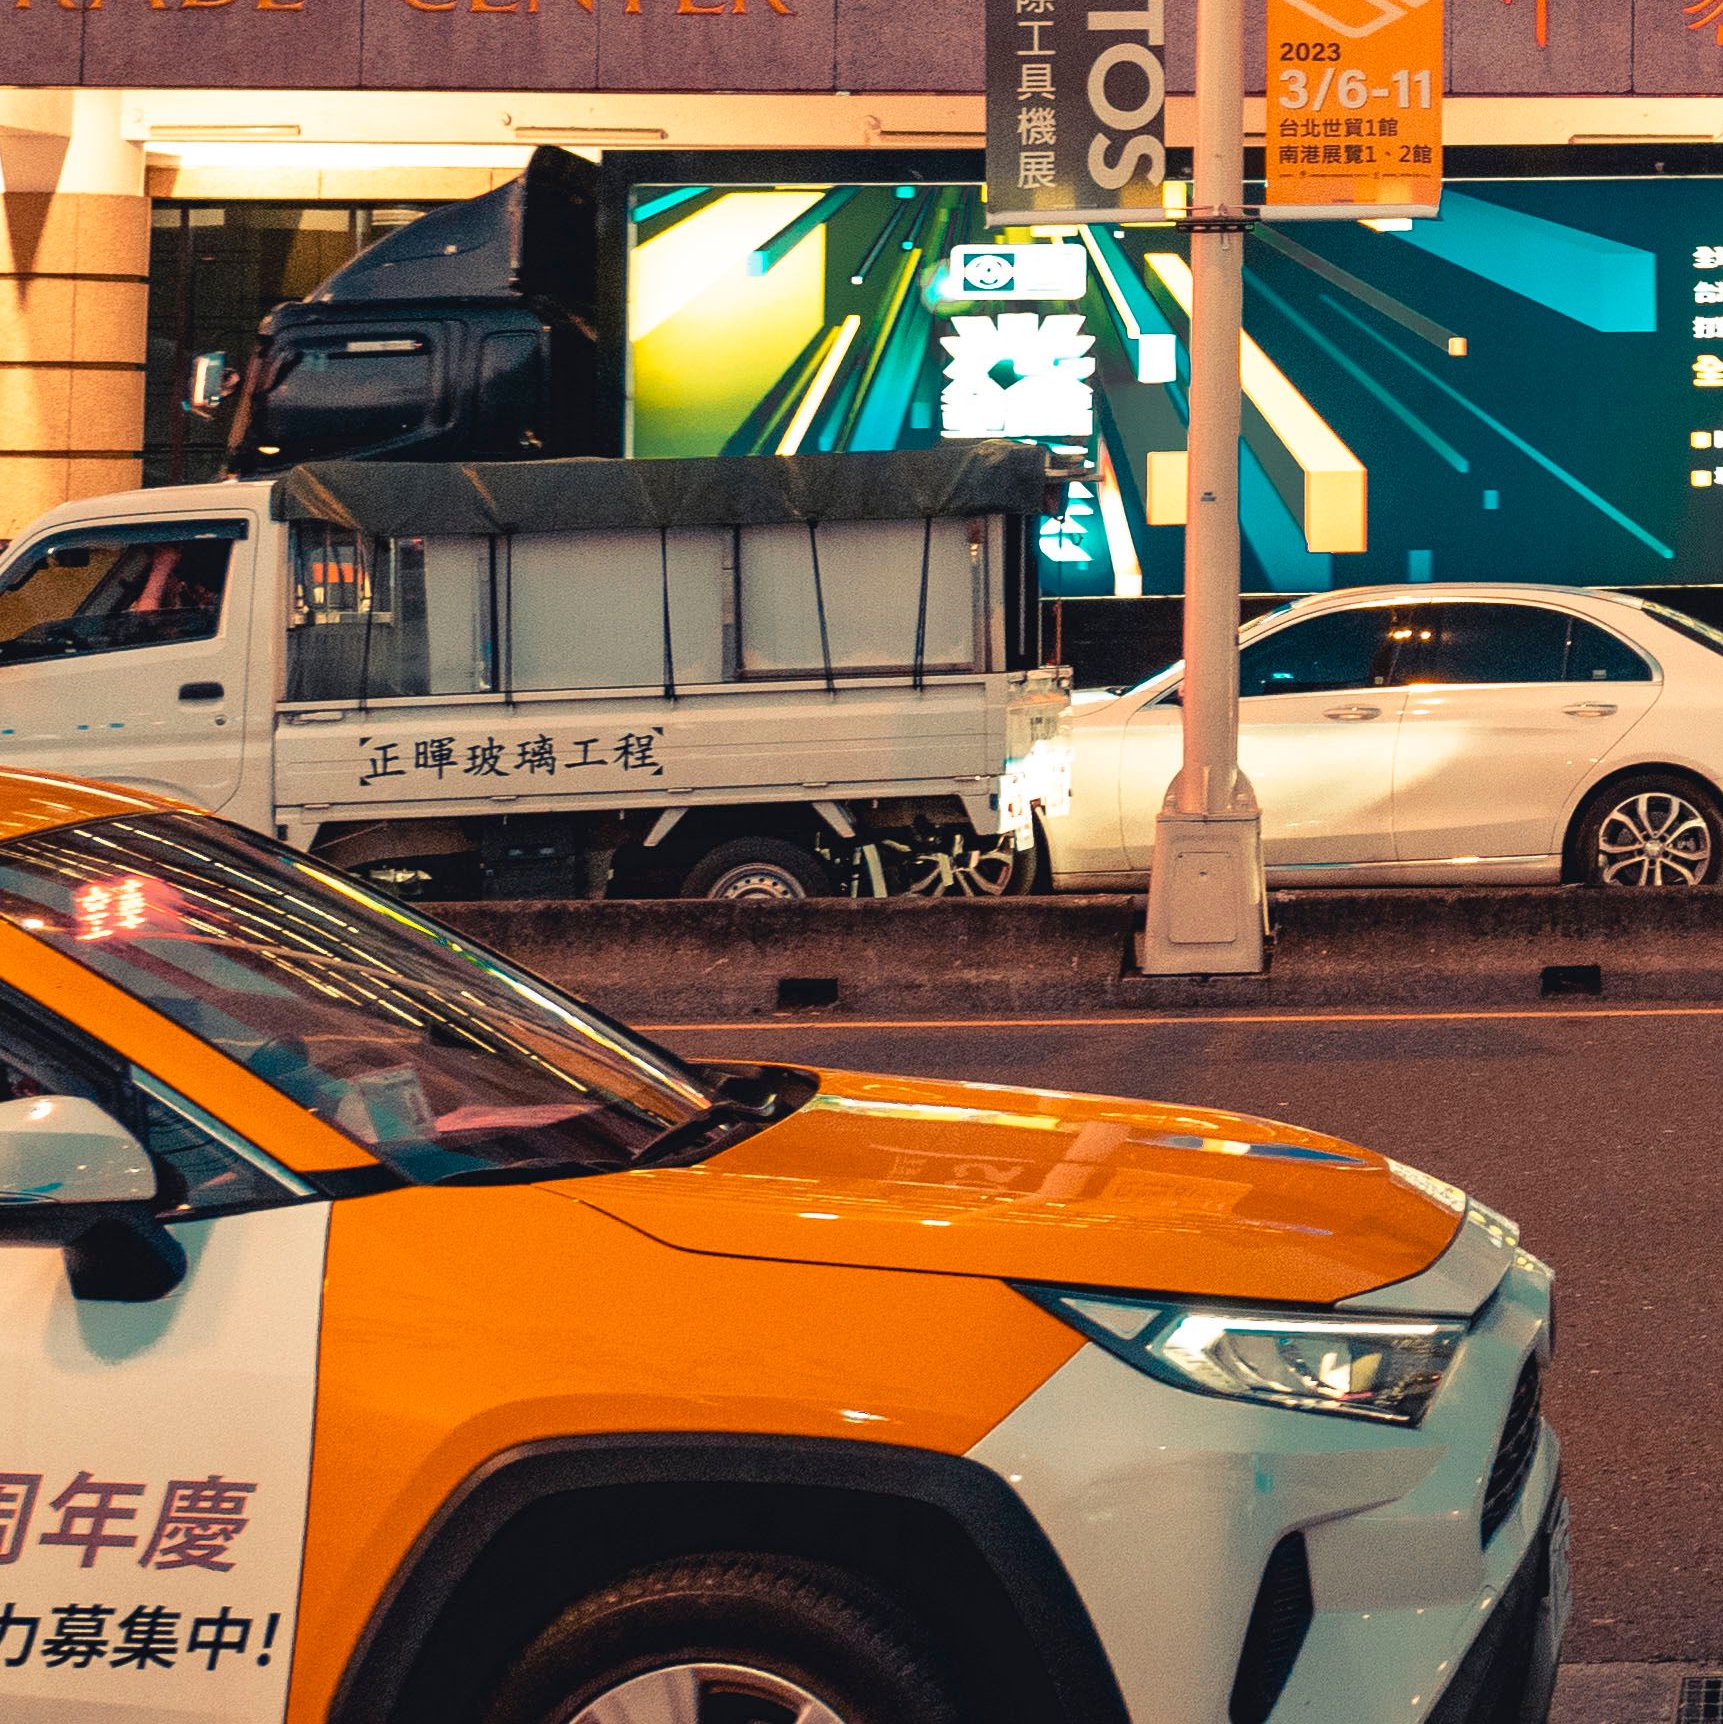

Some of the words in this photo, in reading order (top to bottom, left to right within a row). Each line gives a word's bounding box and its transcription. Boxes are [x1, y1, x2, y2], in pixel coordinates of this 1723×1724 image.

[1279, 41, 1342, 63] 2023
[1278, 67, 1432, 113] 3/6-11
[1279, 117, 1398, 138] 台北世貿1館
[1279, 143, 1433, 165] 南港展覽1、2館
[364, 733, 660, 781] 正暉玻璃工程
